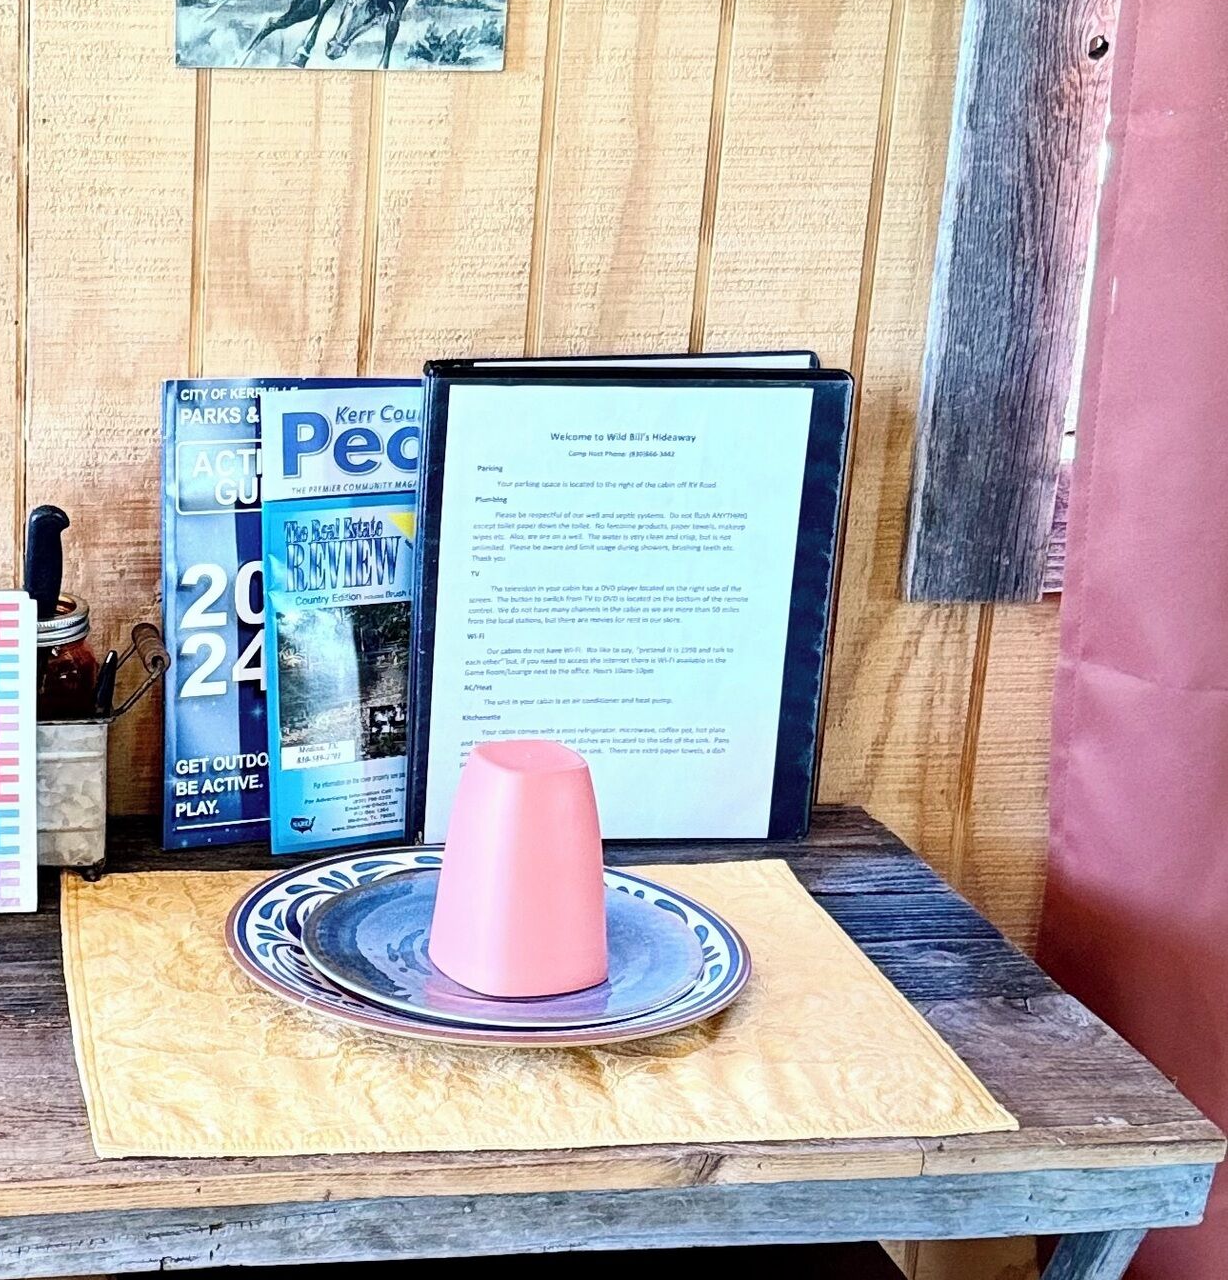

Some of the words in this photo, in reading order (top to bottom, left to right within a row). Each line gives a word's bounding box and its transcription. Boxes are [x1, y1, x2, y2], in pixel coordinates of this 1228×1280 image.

[180, 389, 208, 401] CITY
[211, 388, 227, 400] OF
[180, 407, 241, 424] PARKS
[246, 406, 259, 423] &
[335, 406, 375, 424] Kerr
[380, 405, 421, 423] Cou
[550, 433, 592, 441] Welcome
[606, 433, 628, 441] Wild
[629, 433, 650, 441] Bill's
[652, 433, 697, 443] Hideaway
[477, 465, 503, 473] Parking
[292, 486, 306, 495] THE
[308, 484, 341, 493] PREMIER
[343, 482, 392, 491] COMMUNITY
[284, 520, 308, 543] The
[312, 518, 340, 541] Real
[343, 515, 383, 539] Estate
[285, 536, 402, 593] REVIEW
[295, 595, 329, 605] Country
[332, 592, 362, 603] Edition
[175, 757, 209, 775] GET
[175, 781, 198, 796] BE
[201, 774, 264, 794] ACTIVE.
[175, 800, 220, 818] PLAY.
